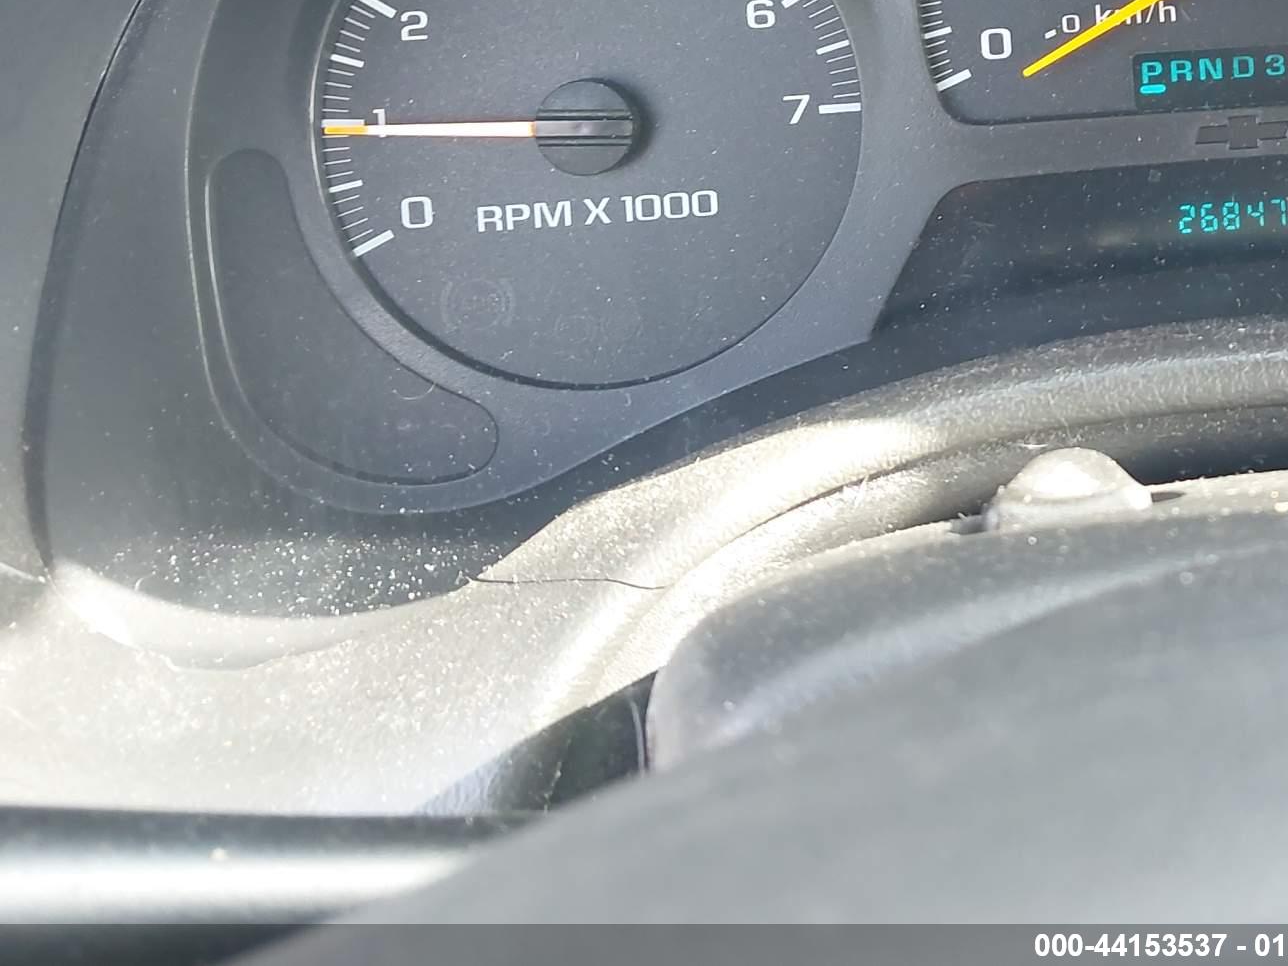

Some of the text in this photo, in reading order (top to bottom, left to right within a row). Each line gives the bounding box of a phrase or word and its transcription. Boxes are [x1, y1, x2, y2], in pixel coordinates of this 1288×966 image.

[401, 11, 428, 40] 2
[747, 0, 775, 28] 6
[1062, 15, 1080, 32] 0
[981, 28, 1011, 59] 0
[372, 108, 387, 138] 1
[783, 95, 809, 124] 7
[401, 196, 433, 229] 0
[477, 191, 718, 232] RPM X 1000
